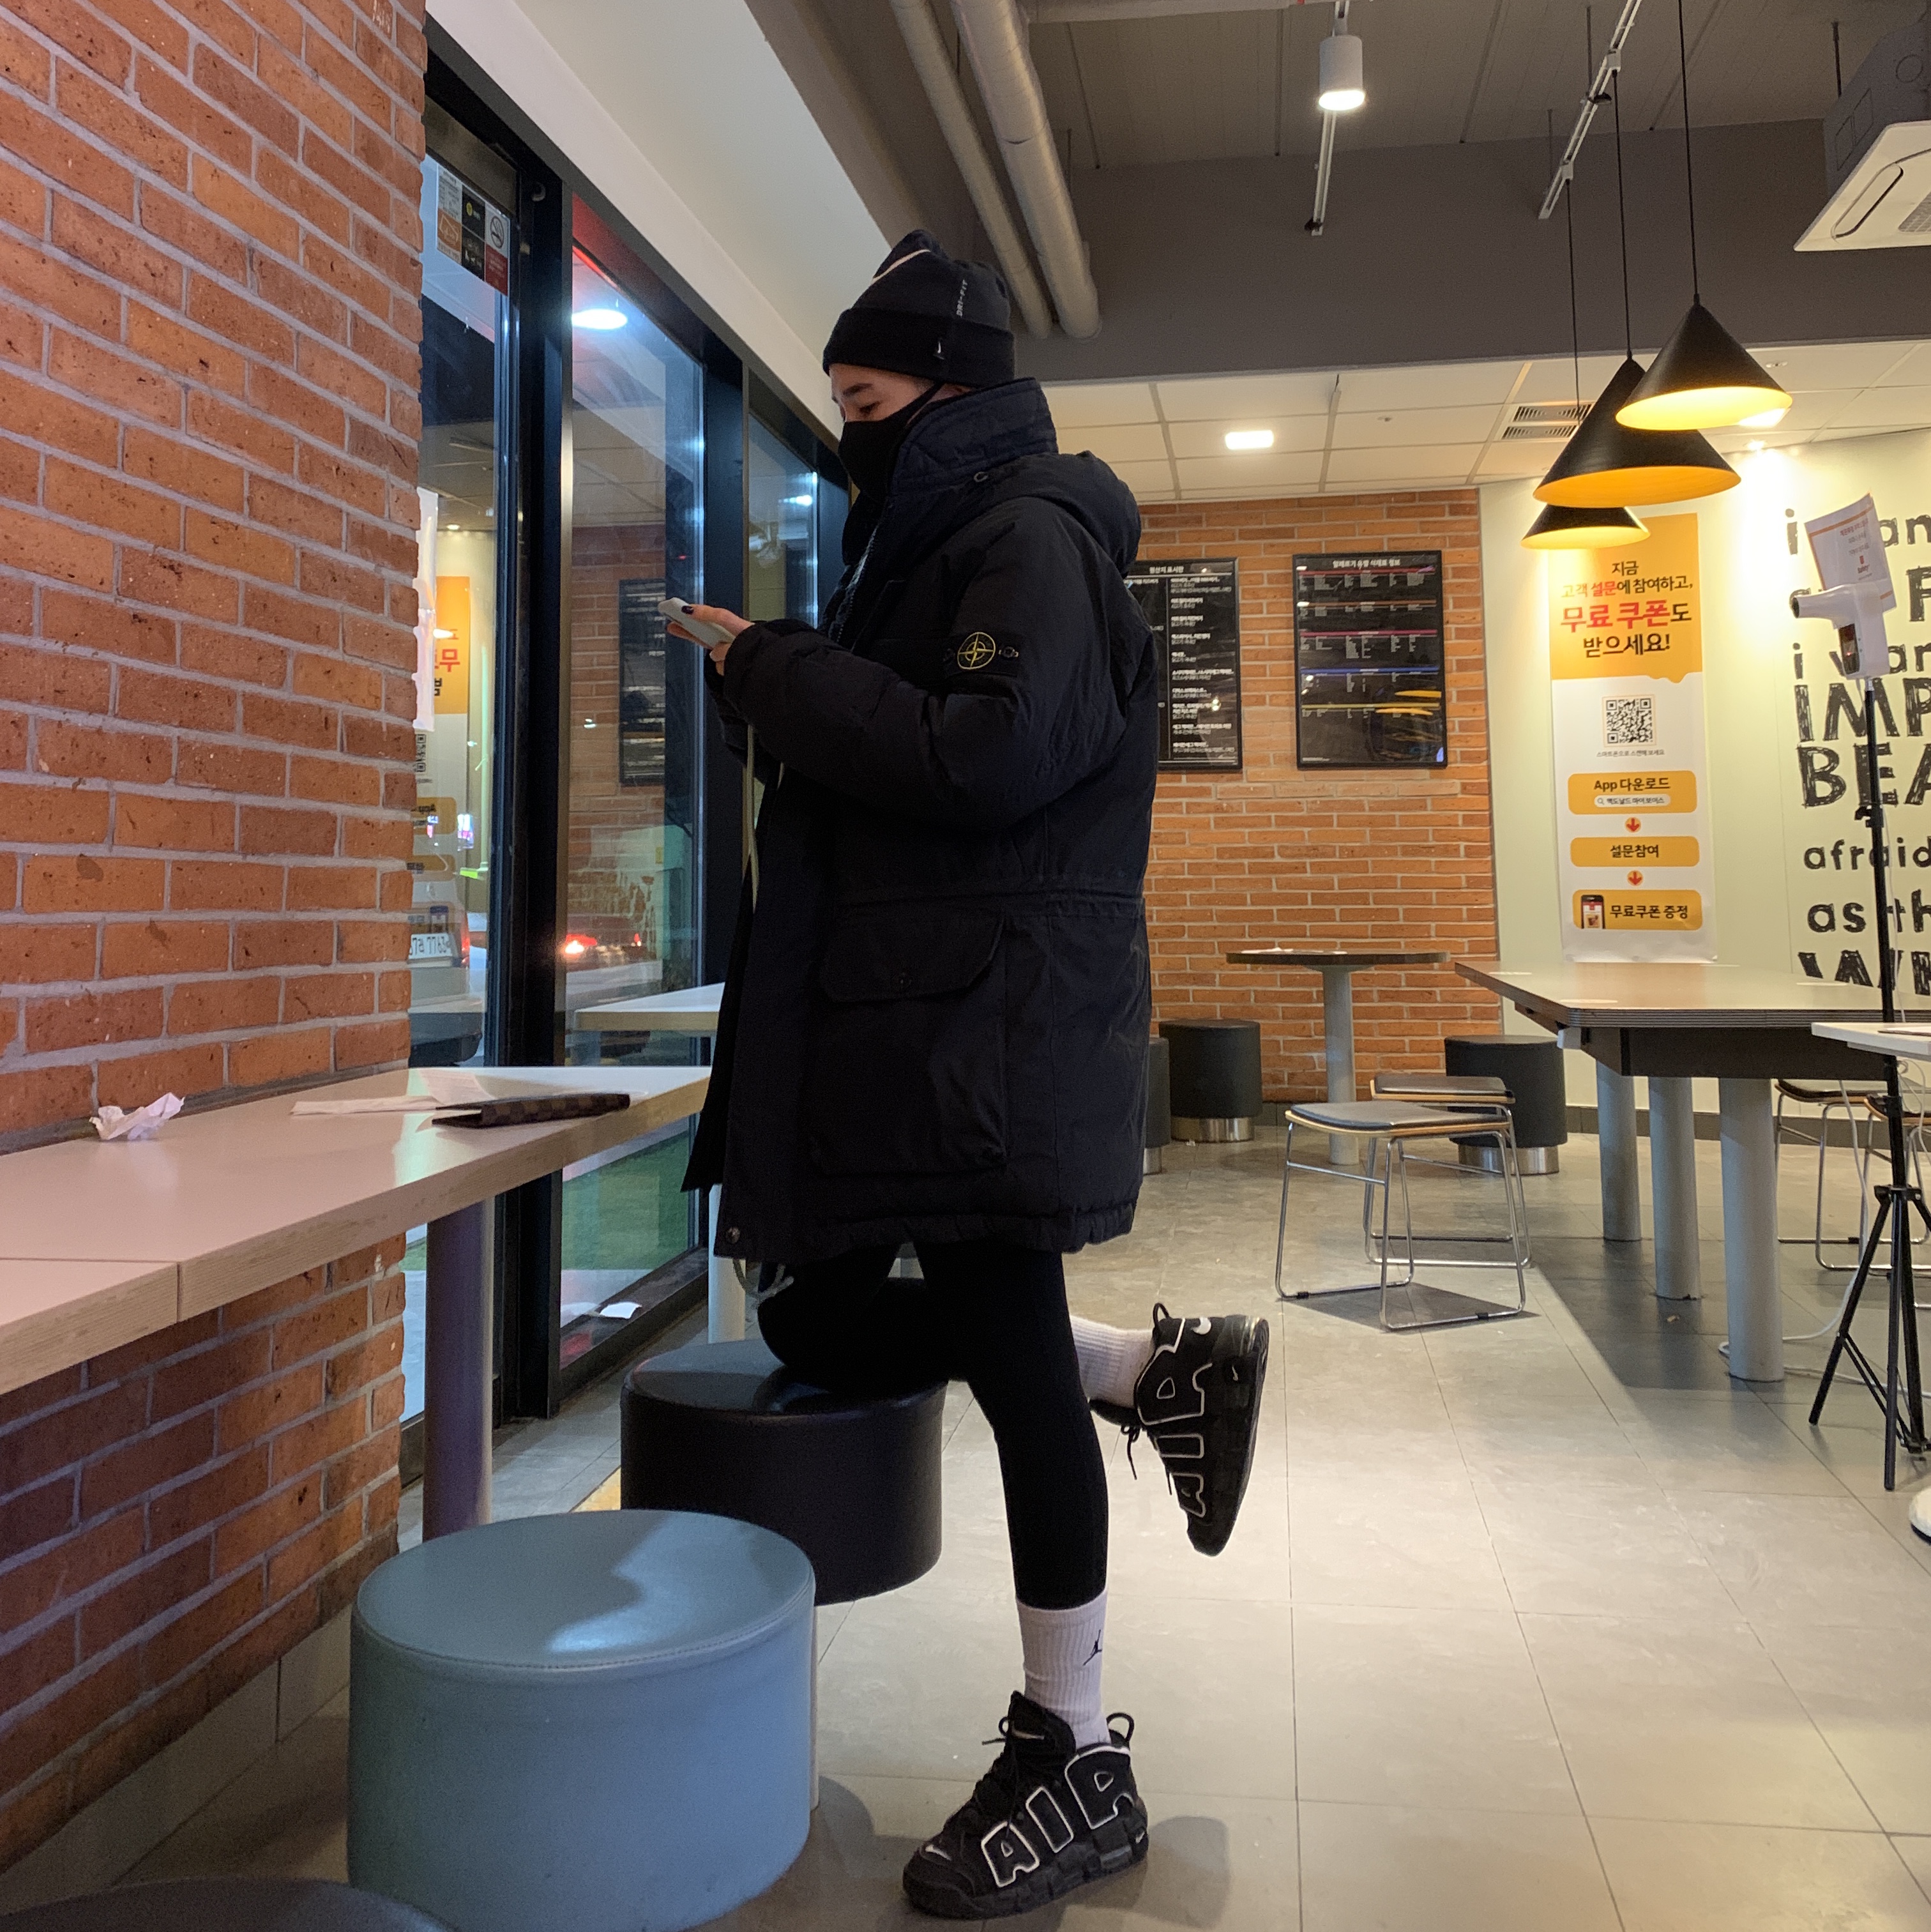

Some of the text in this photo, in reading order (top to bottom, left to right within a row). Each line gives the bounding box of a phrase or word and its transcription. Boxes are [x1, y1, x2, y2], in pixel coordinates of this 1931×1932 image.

[1612, 560, 1639, 576] 지금
[1561, 575, 1693, 598] 고객 설문에 참여하고,
[1560, 599, 1692, 633] 무료 쿠폰도
[1583, 633, 1670, 658] 받으세요!
[1594, 777, 1671, 792] App 다운로드
[1610, 844, 1660, 858] 설문참여
[1663, 904, 1689, 920] 증정
[1807, 902, 1867, 933] as
[981, 1746, 1134, 1887] AIR
